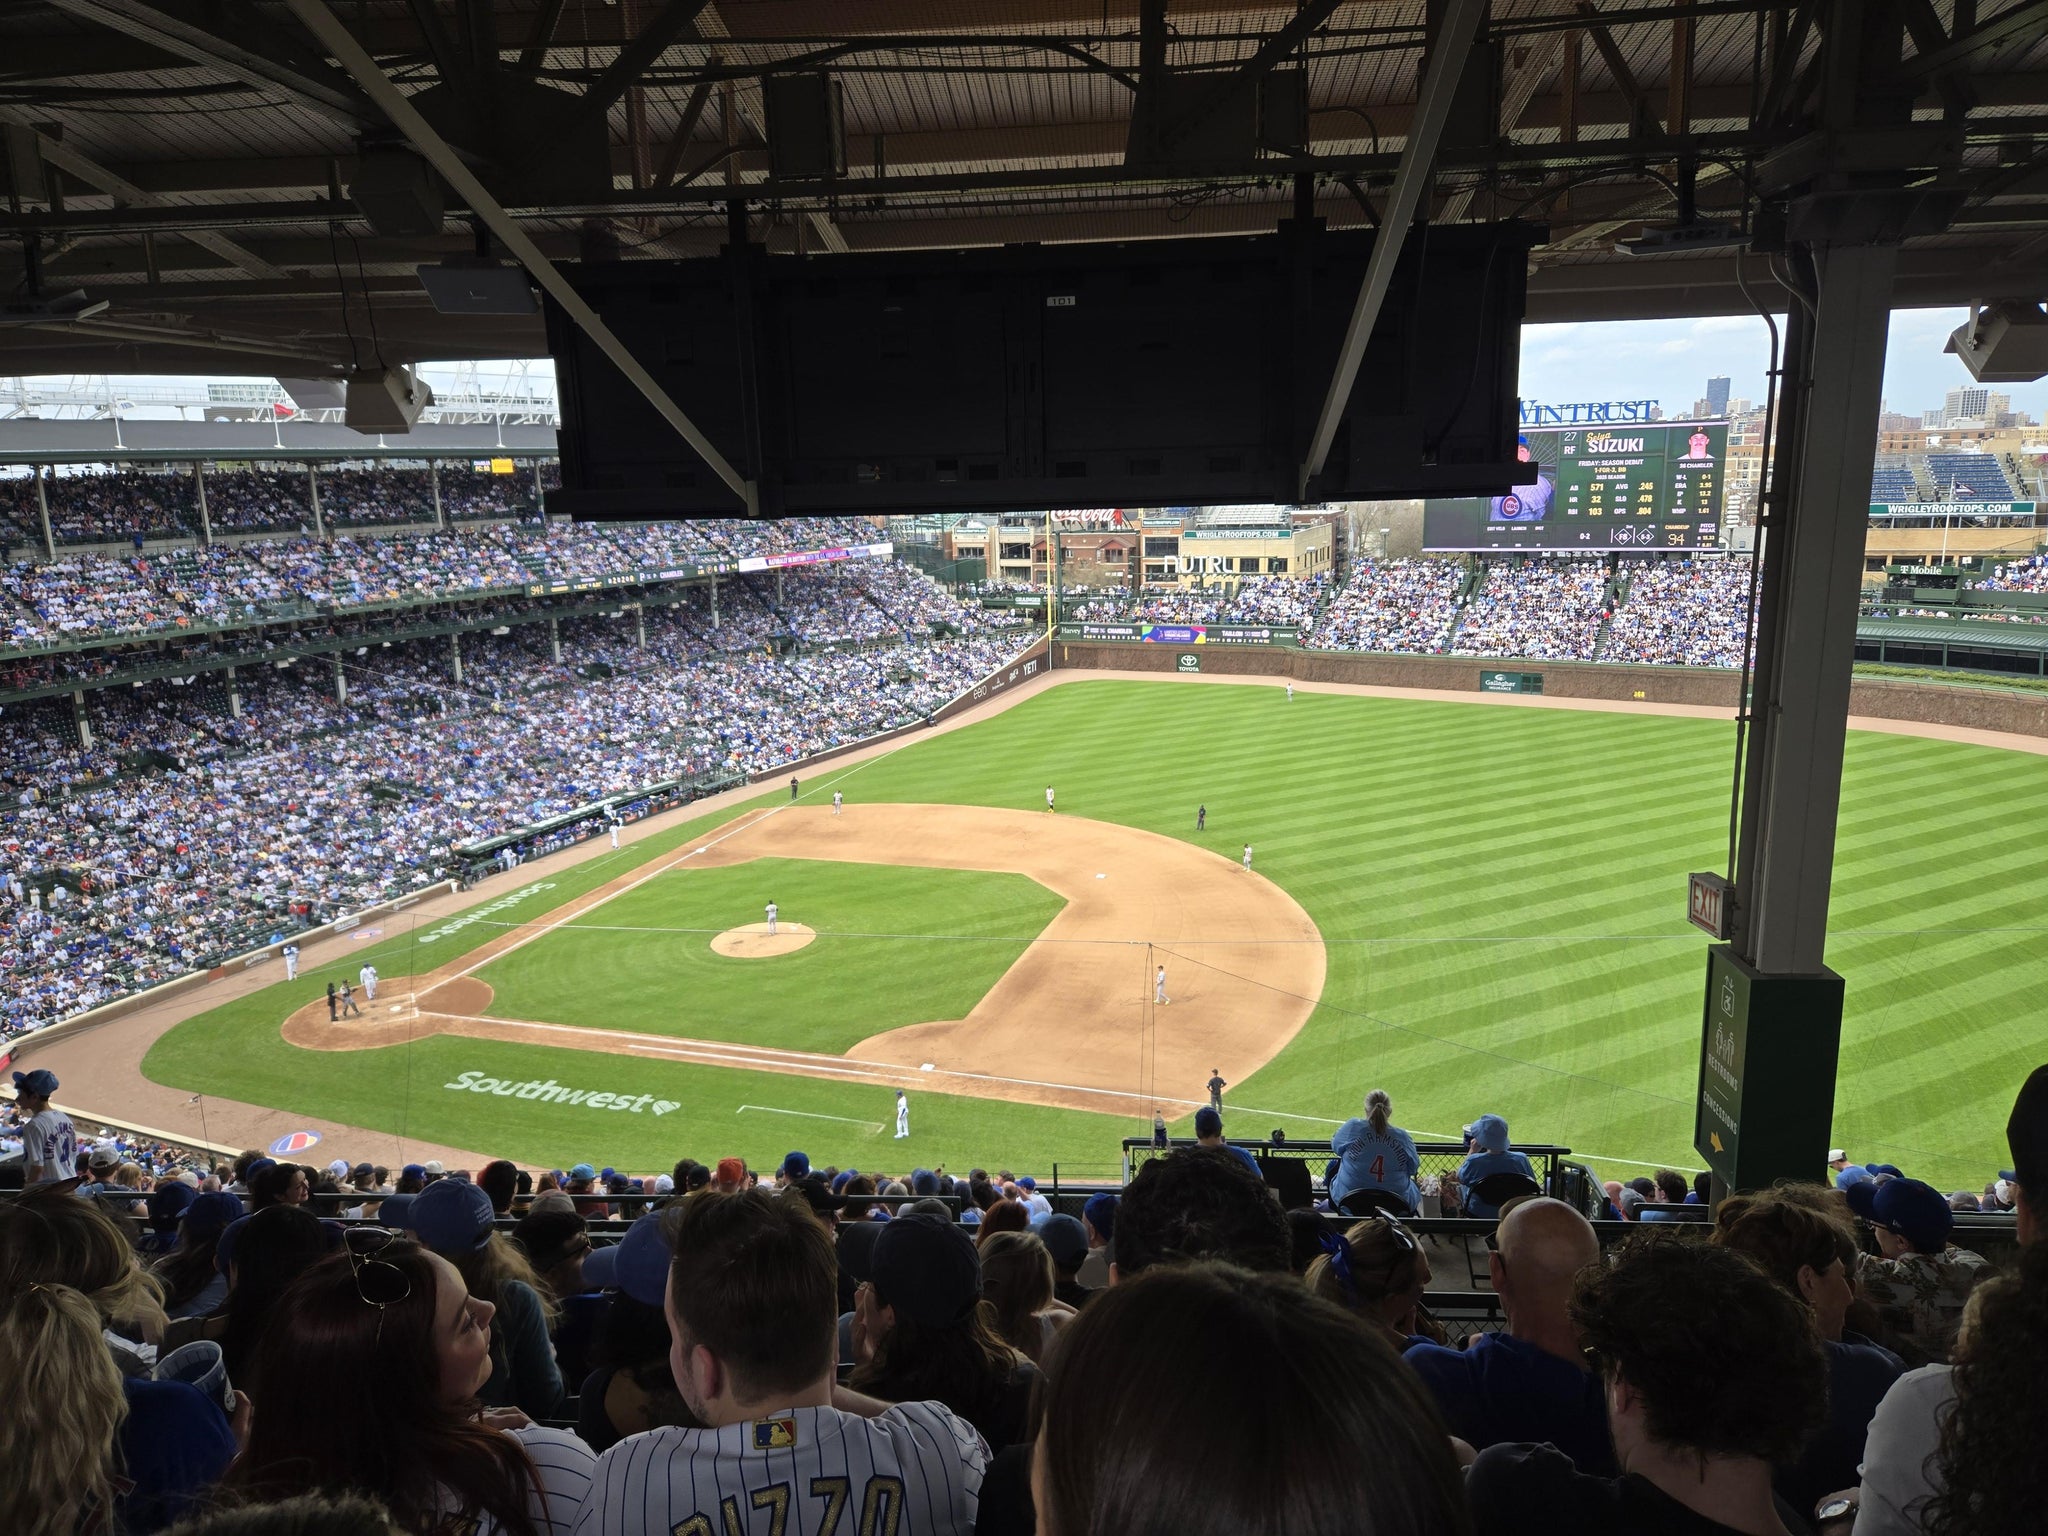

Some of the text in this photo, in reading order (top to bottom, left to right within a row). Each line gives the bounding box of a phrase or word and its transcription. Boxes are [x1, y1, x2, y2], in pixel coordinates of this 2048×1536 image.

[1564, 432, 1577, 442] 27
[1563, 446, 1577, 455] RF
[1588, 437, 1644, 453] SUZUKI
[1590, 483, 1604, 491] 571
[1591, 495, 1601, 503] 32
[1588, 507, 1602, 515] 103
[1668, 533, 1685, 546] 94
[1910, 565, 1942, 575] Mobile
[1061, 626, 1081, 635] Harvey
[1022, 660, 1037, 676] YETI
[1485, 679, 1516, 688] Gallagher
[1693, 881, 1720, 924] EXIT
[430, 882, 557, 941] Southwest
[1706, 1052, 1738, 1092] RESTROOMS
[443, 1071, 654, 1112] Southwest
[1703, 1090, 1738, 1135] CONCESSIONS
[1369, 1154, 1385, 1183] 4
